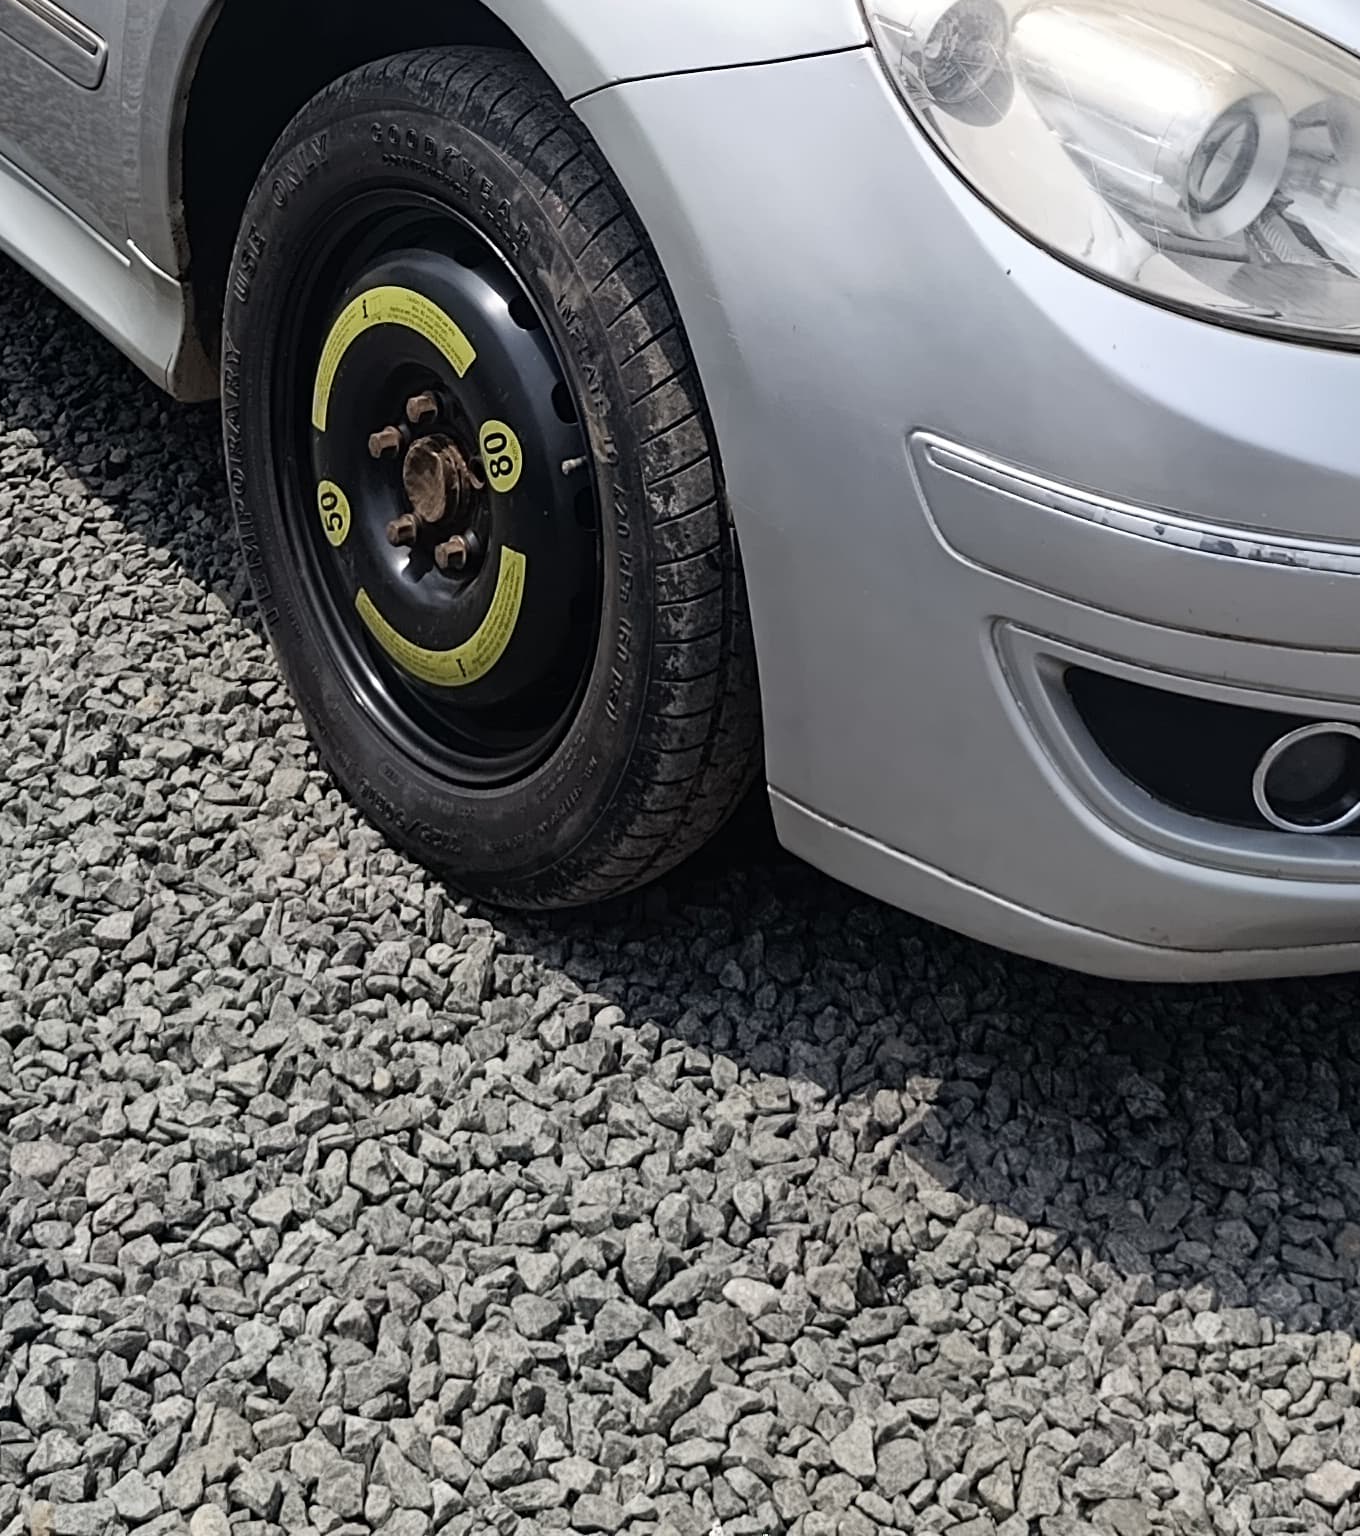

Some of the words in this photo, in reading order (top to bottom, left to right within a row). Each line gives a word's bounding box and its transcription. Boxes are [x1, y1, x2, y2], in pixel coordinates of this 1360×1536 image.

[271, 129, 330, 207] ONLY
[371, 122, 531, 248] GOODYEAR
[233, 223, 267, 304] USE
[224, 330, 280, 628] TEMPORARY
[483, 432, 515, 479] 80
[320, 491, 344, 532] 50
